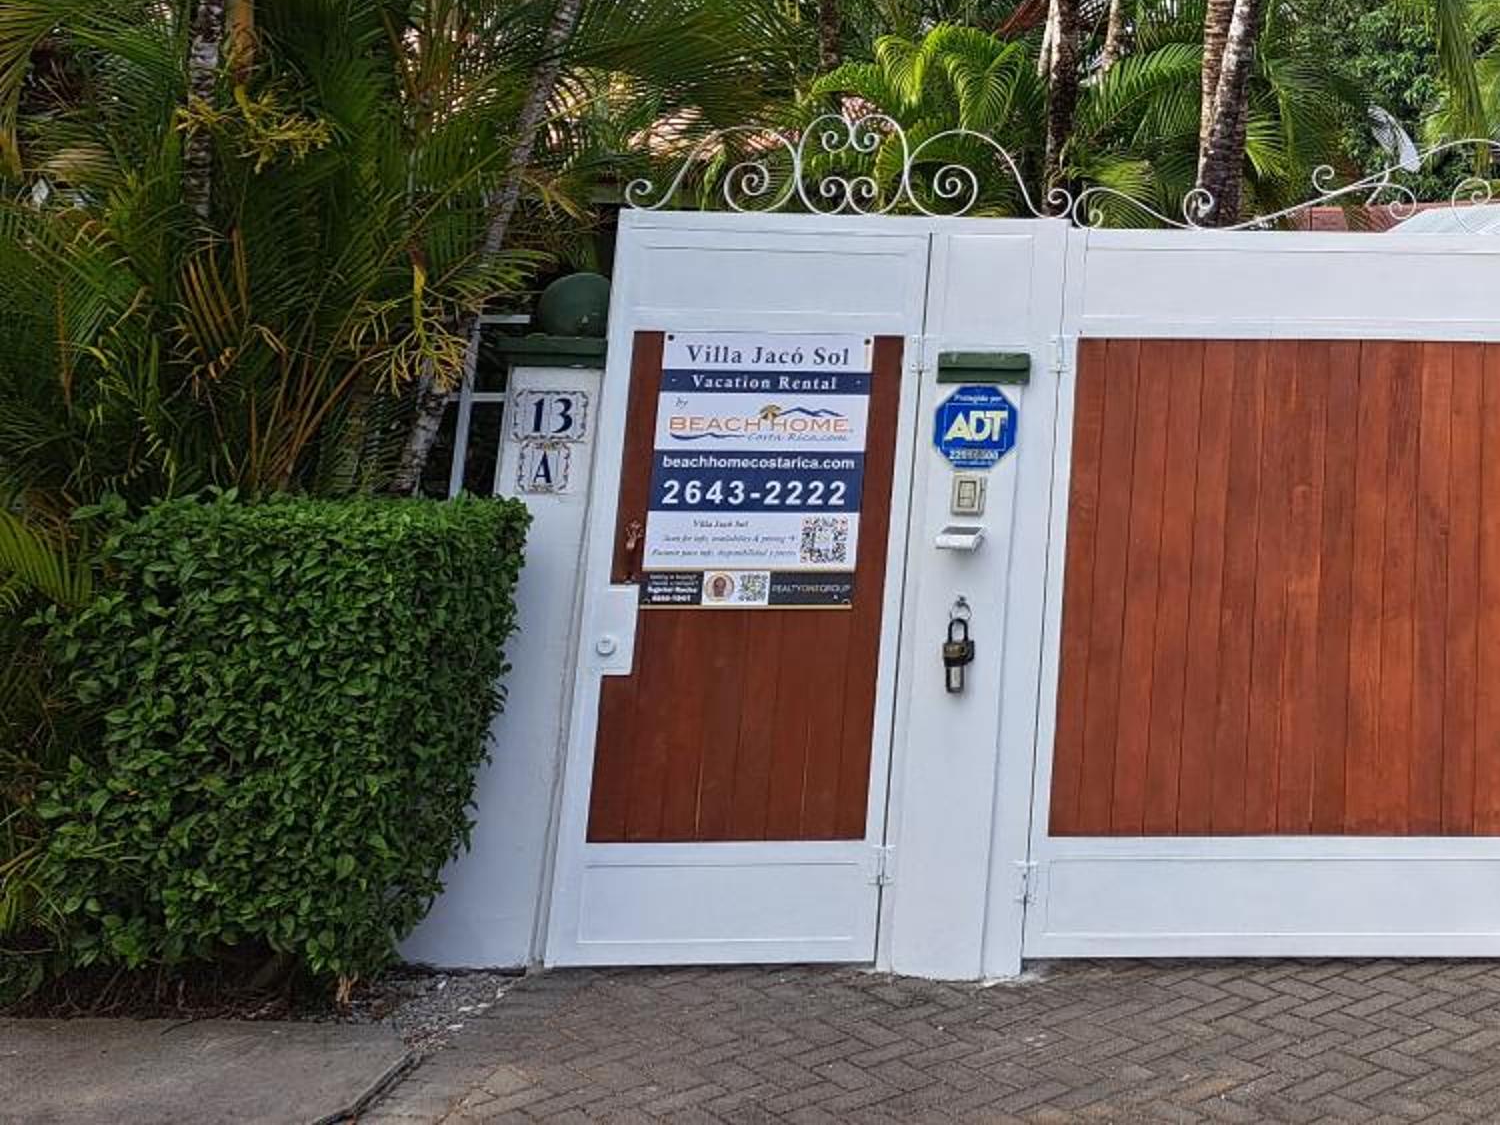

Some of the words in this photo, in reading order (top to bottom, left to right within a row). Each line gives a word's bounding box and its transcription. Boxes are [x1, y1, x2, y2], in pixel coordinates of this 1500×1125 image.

[686, 344, 742, 364] Villa
[751, 343, 804, 366] Jacó
[813, 347, 850, 366] Sol
[691, 374, 771, 389] Vacation
[778, 375, 838, 390] Rental
[674, 396, 689, 410] by
[532, 397, 573, 434] 13
[669, 416, 761, 433] BEACH
[769, 417, 849, 433] HOME
[943, 410, 1009, 442] ADT
[533, 450, 553, 484] A
[662, 455, 856, 471] beachhomecostarica.com
[661, 479, 847, 506] 2643-2222
